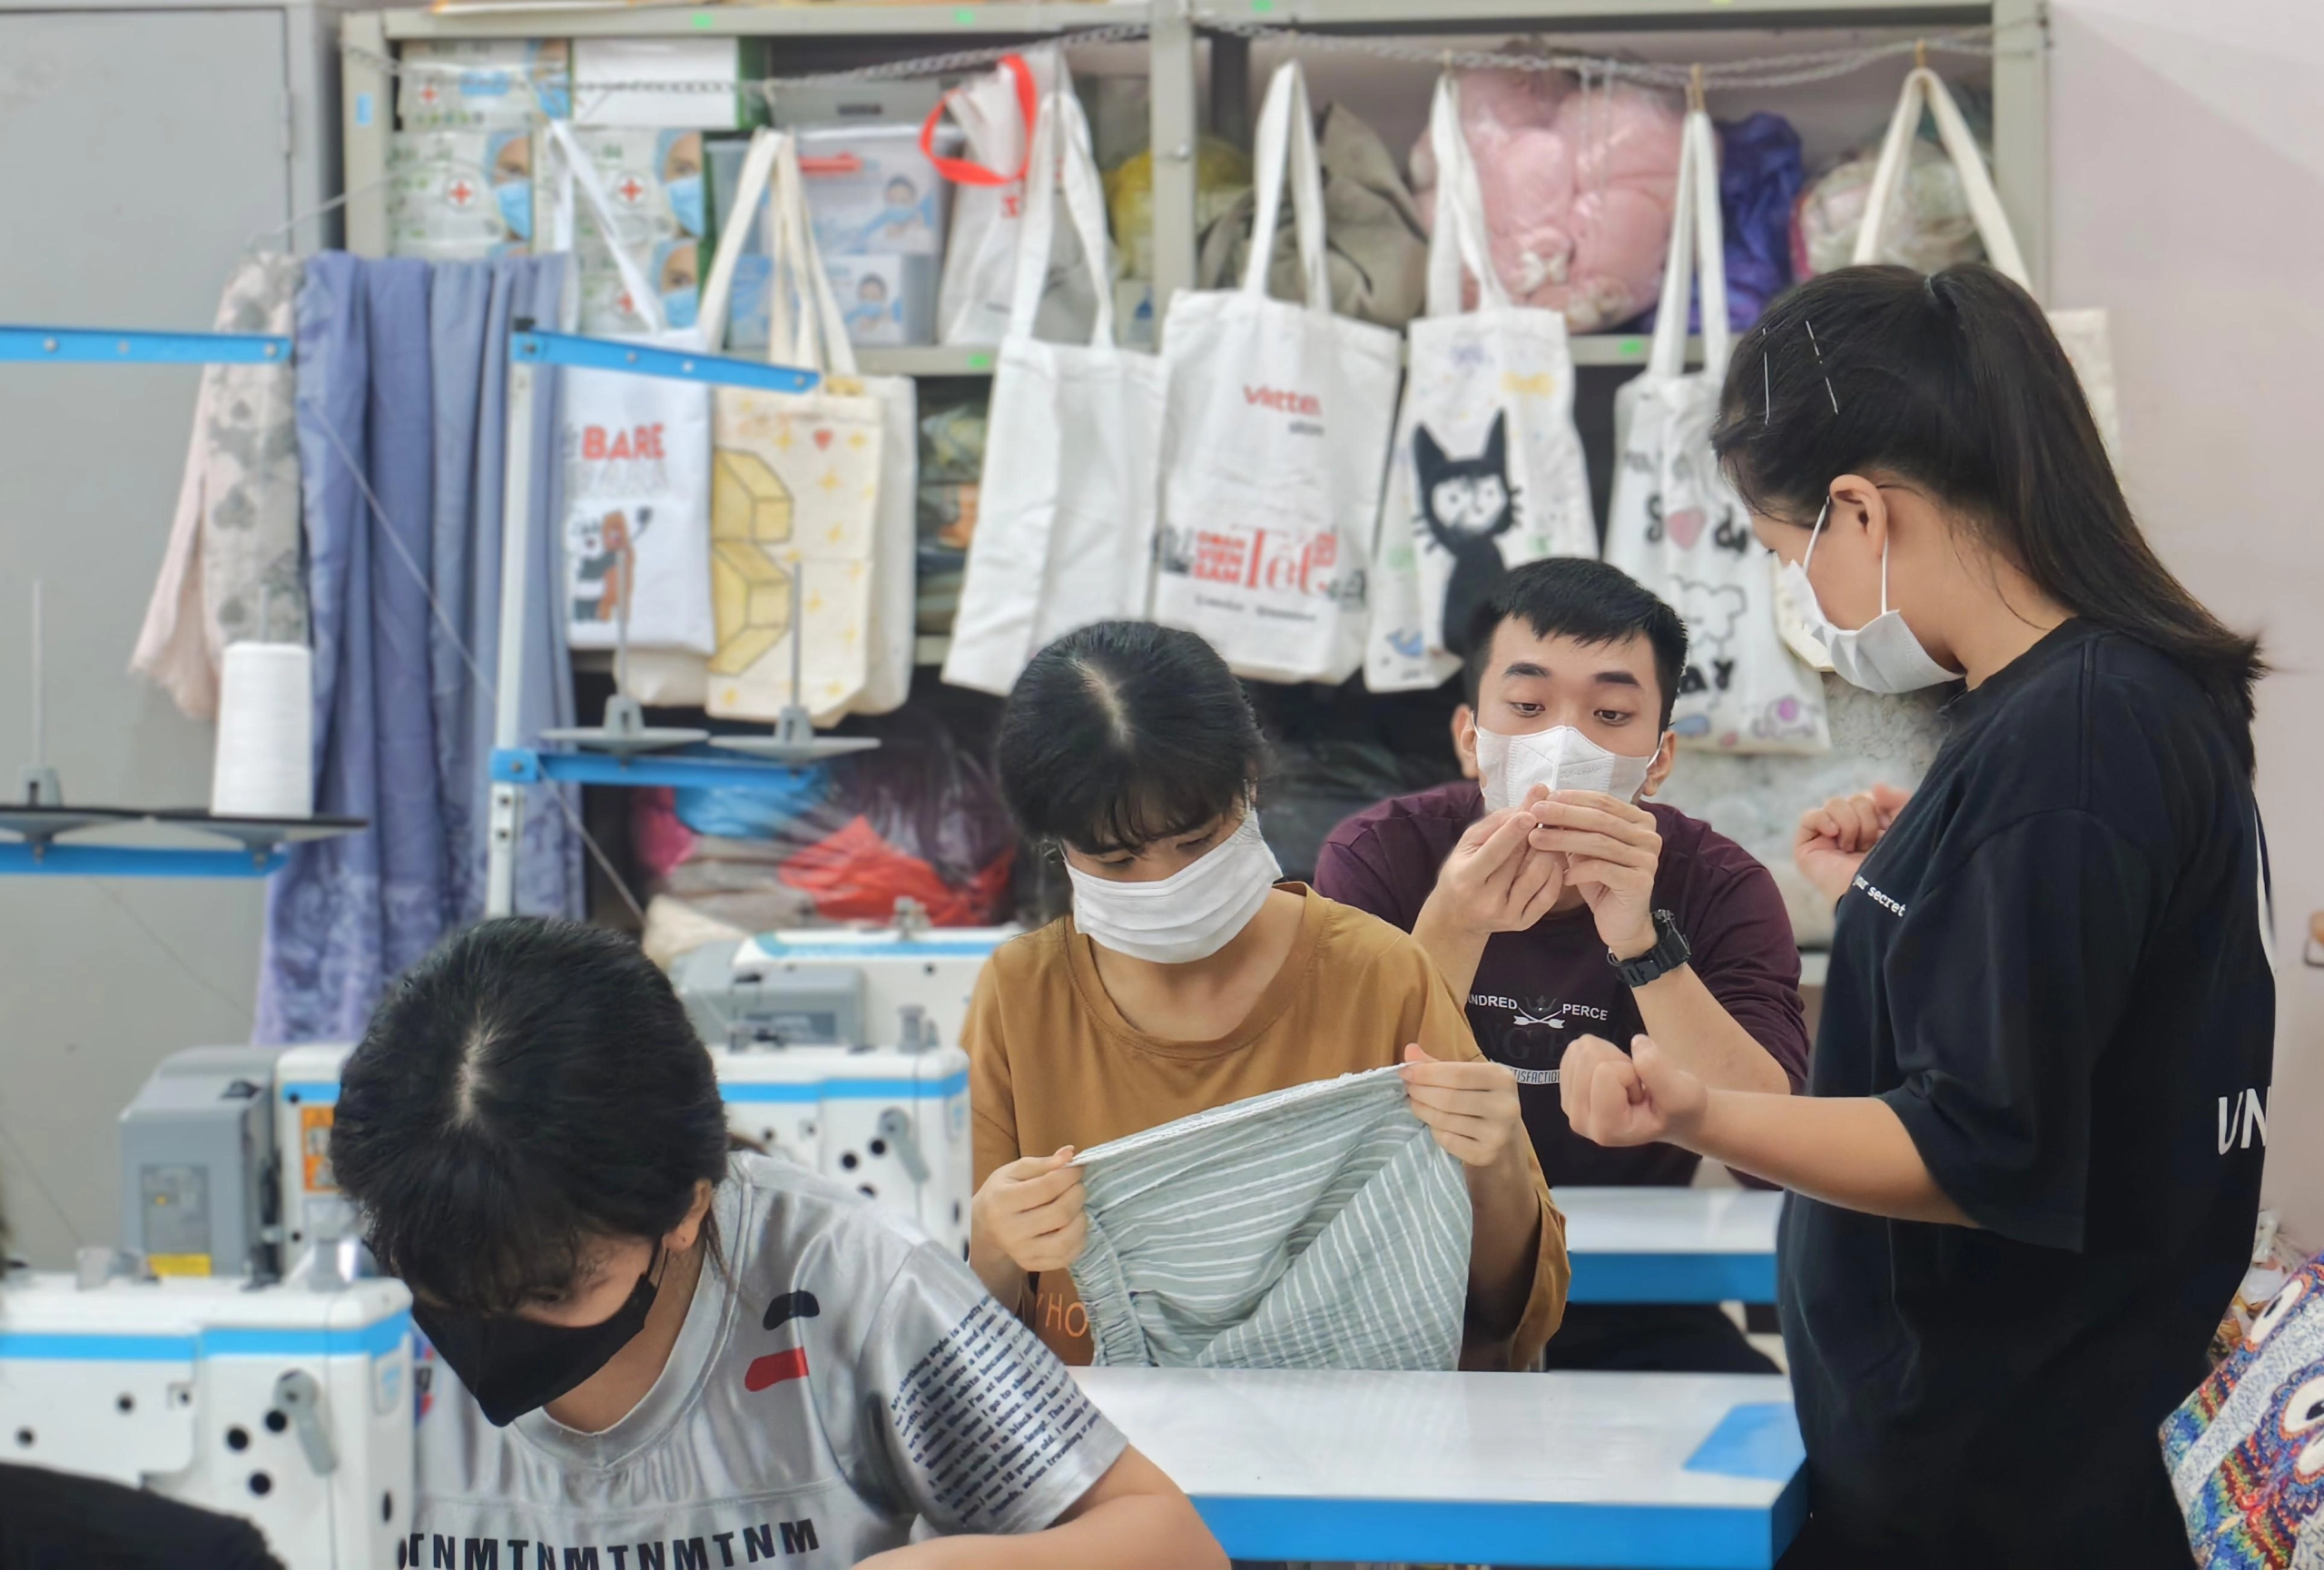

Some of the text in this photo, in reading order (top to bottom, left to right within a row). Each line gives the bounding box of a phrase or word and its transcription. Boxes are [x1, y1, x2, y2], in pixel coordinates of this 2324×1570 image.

[581, 423, 665, 461] BARE
[1867, 886, 1906, 917] secret
[1561, 1003, 1609, 1021] PERCE
[1509, 1067, 1560, 1083] TISFACTIO
[978, 1342, 1012, 1376] because
[1008, 1412, 1033, 1435] black
[1032, 1397, 1048, 1413] and
